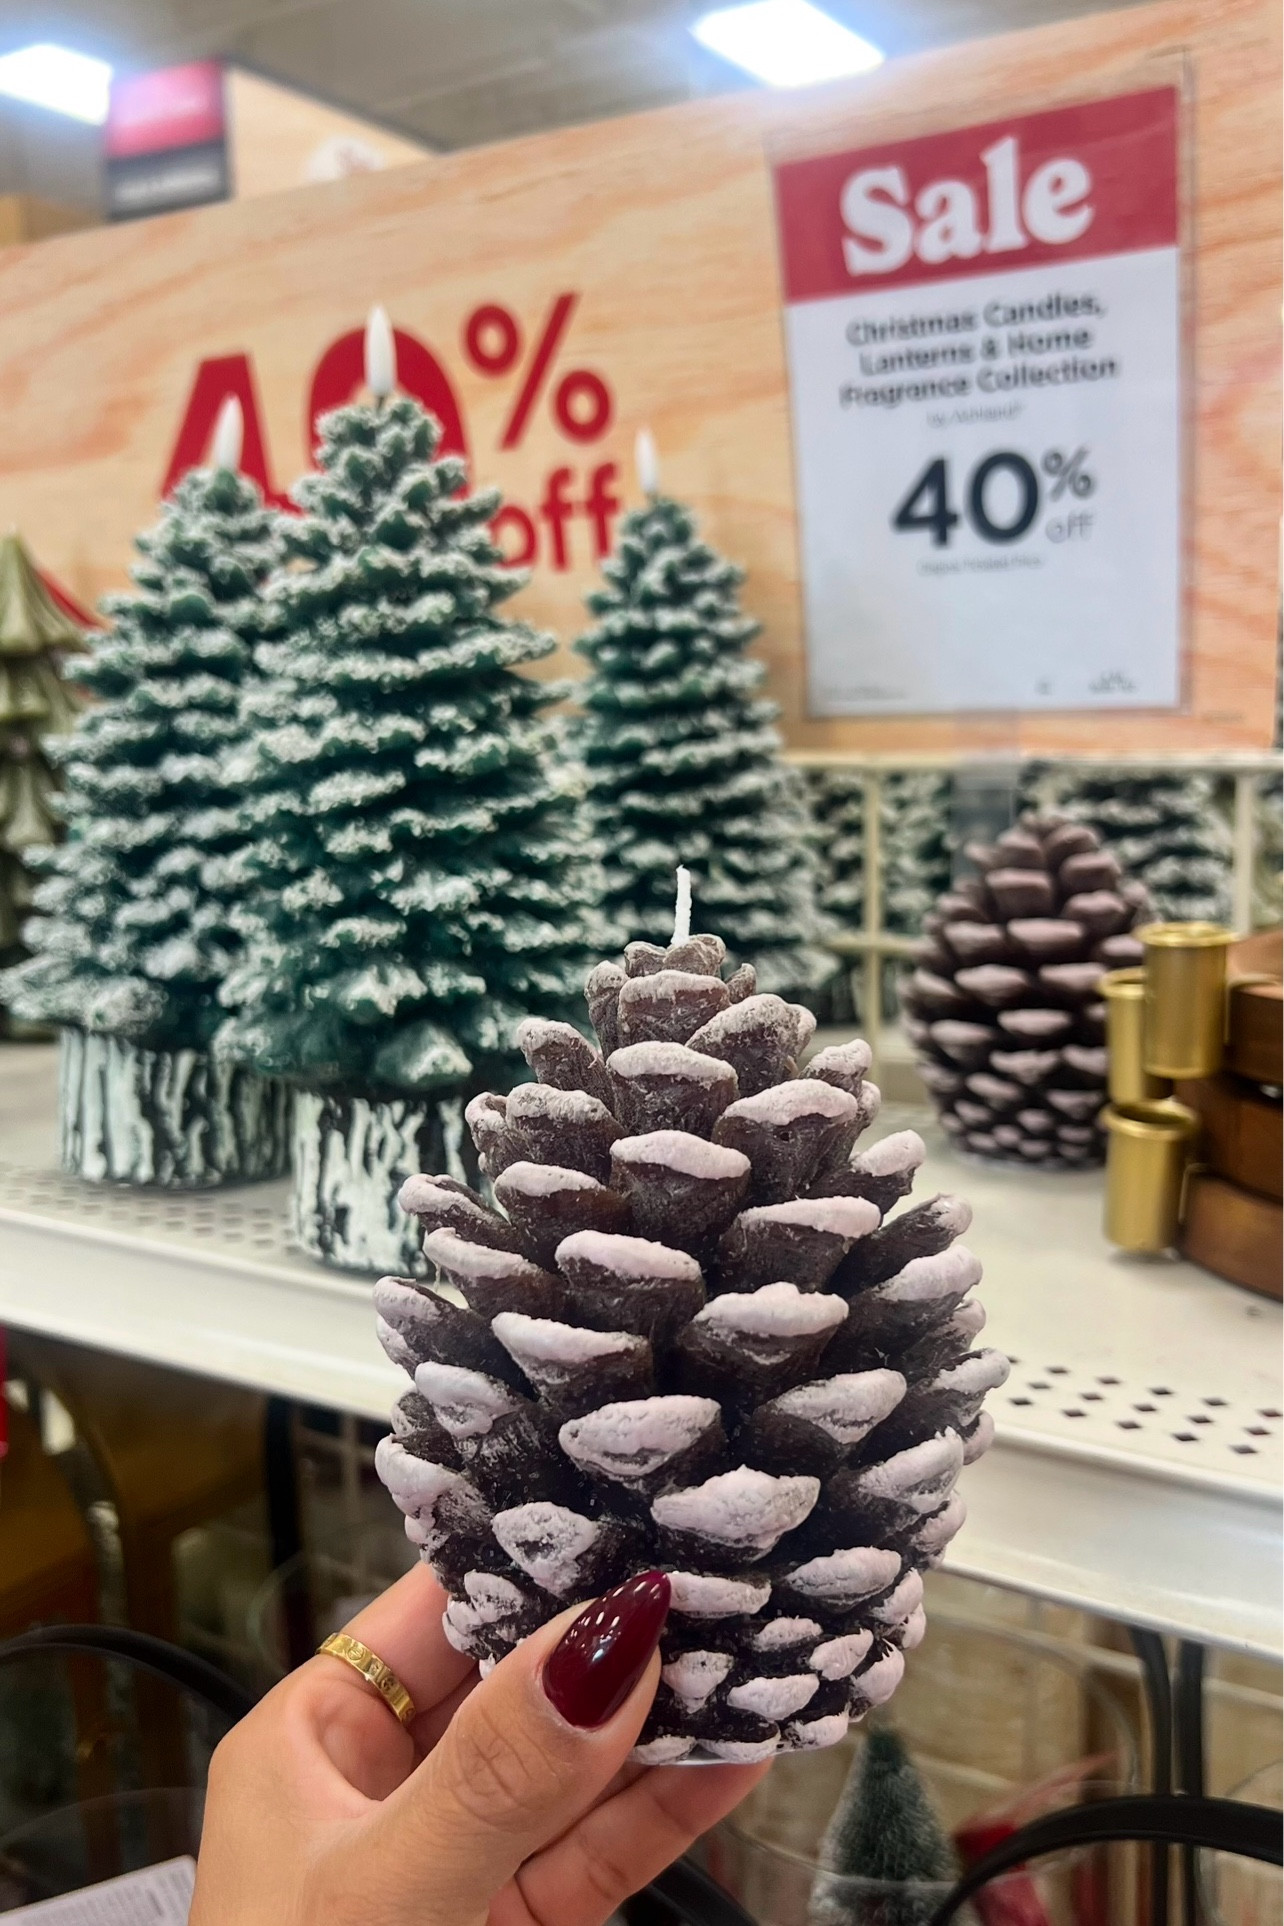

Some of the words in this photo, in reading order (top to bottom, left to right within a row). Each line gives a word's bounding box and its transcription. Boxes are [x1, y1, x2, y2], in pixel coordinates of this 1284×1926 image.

[839, 135, 1094, 276] Sale
[845, 313, 978, 347] Christmas
[982, 292, 1108, 328] Candles,
[859, 343, 976, 376] Lanterns
[980, 335, 1000, 361] &
[1006, 328, 1093, 356] Home
[839, 376, 971, 410] Fragrance
[976, 357, 1119, 394] Collection
[488, 461, 622, 573] off
[892, 444, 1096, 549] 40%
[1045, 510, 1094, 544] off
